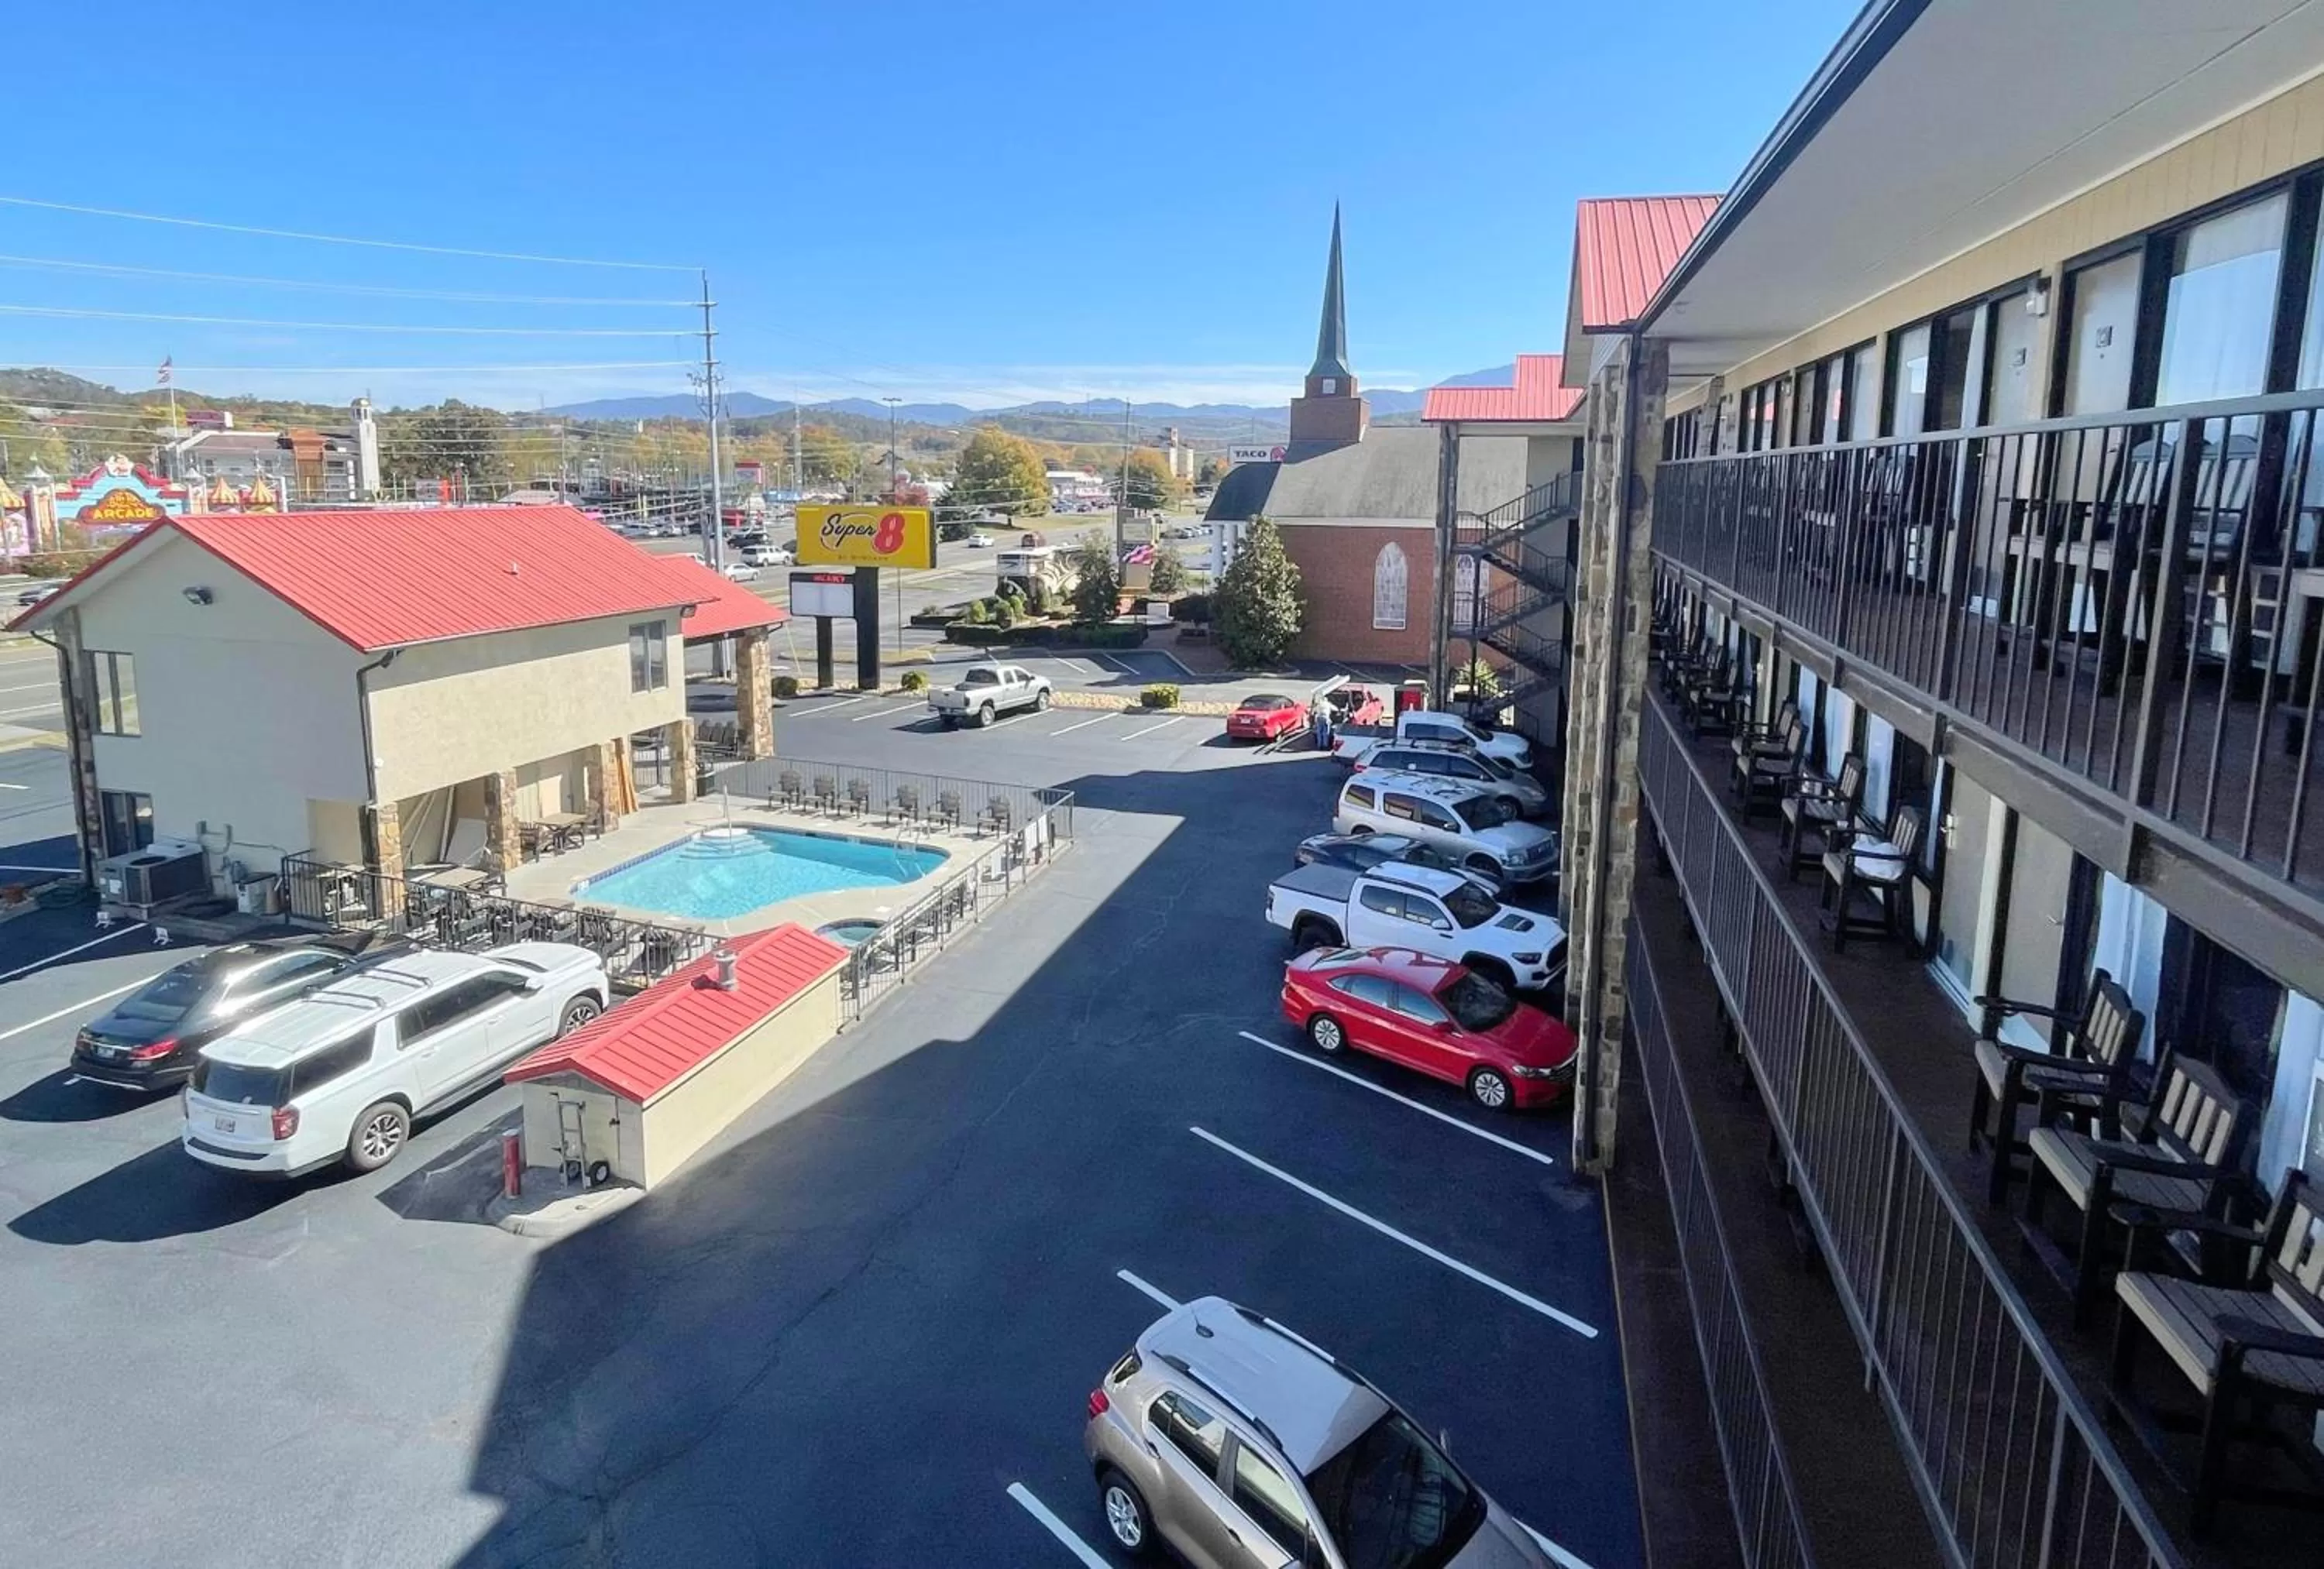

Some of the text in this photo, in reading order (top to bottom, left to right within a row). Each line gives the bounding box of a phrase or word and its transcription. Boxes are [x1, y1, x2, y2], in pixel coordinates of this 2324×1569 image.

[1235, 450, 1267, 458] TACO
[93, 507, 156, 520] ARCADE
[821, 512, 906, 554] Super 8
